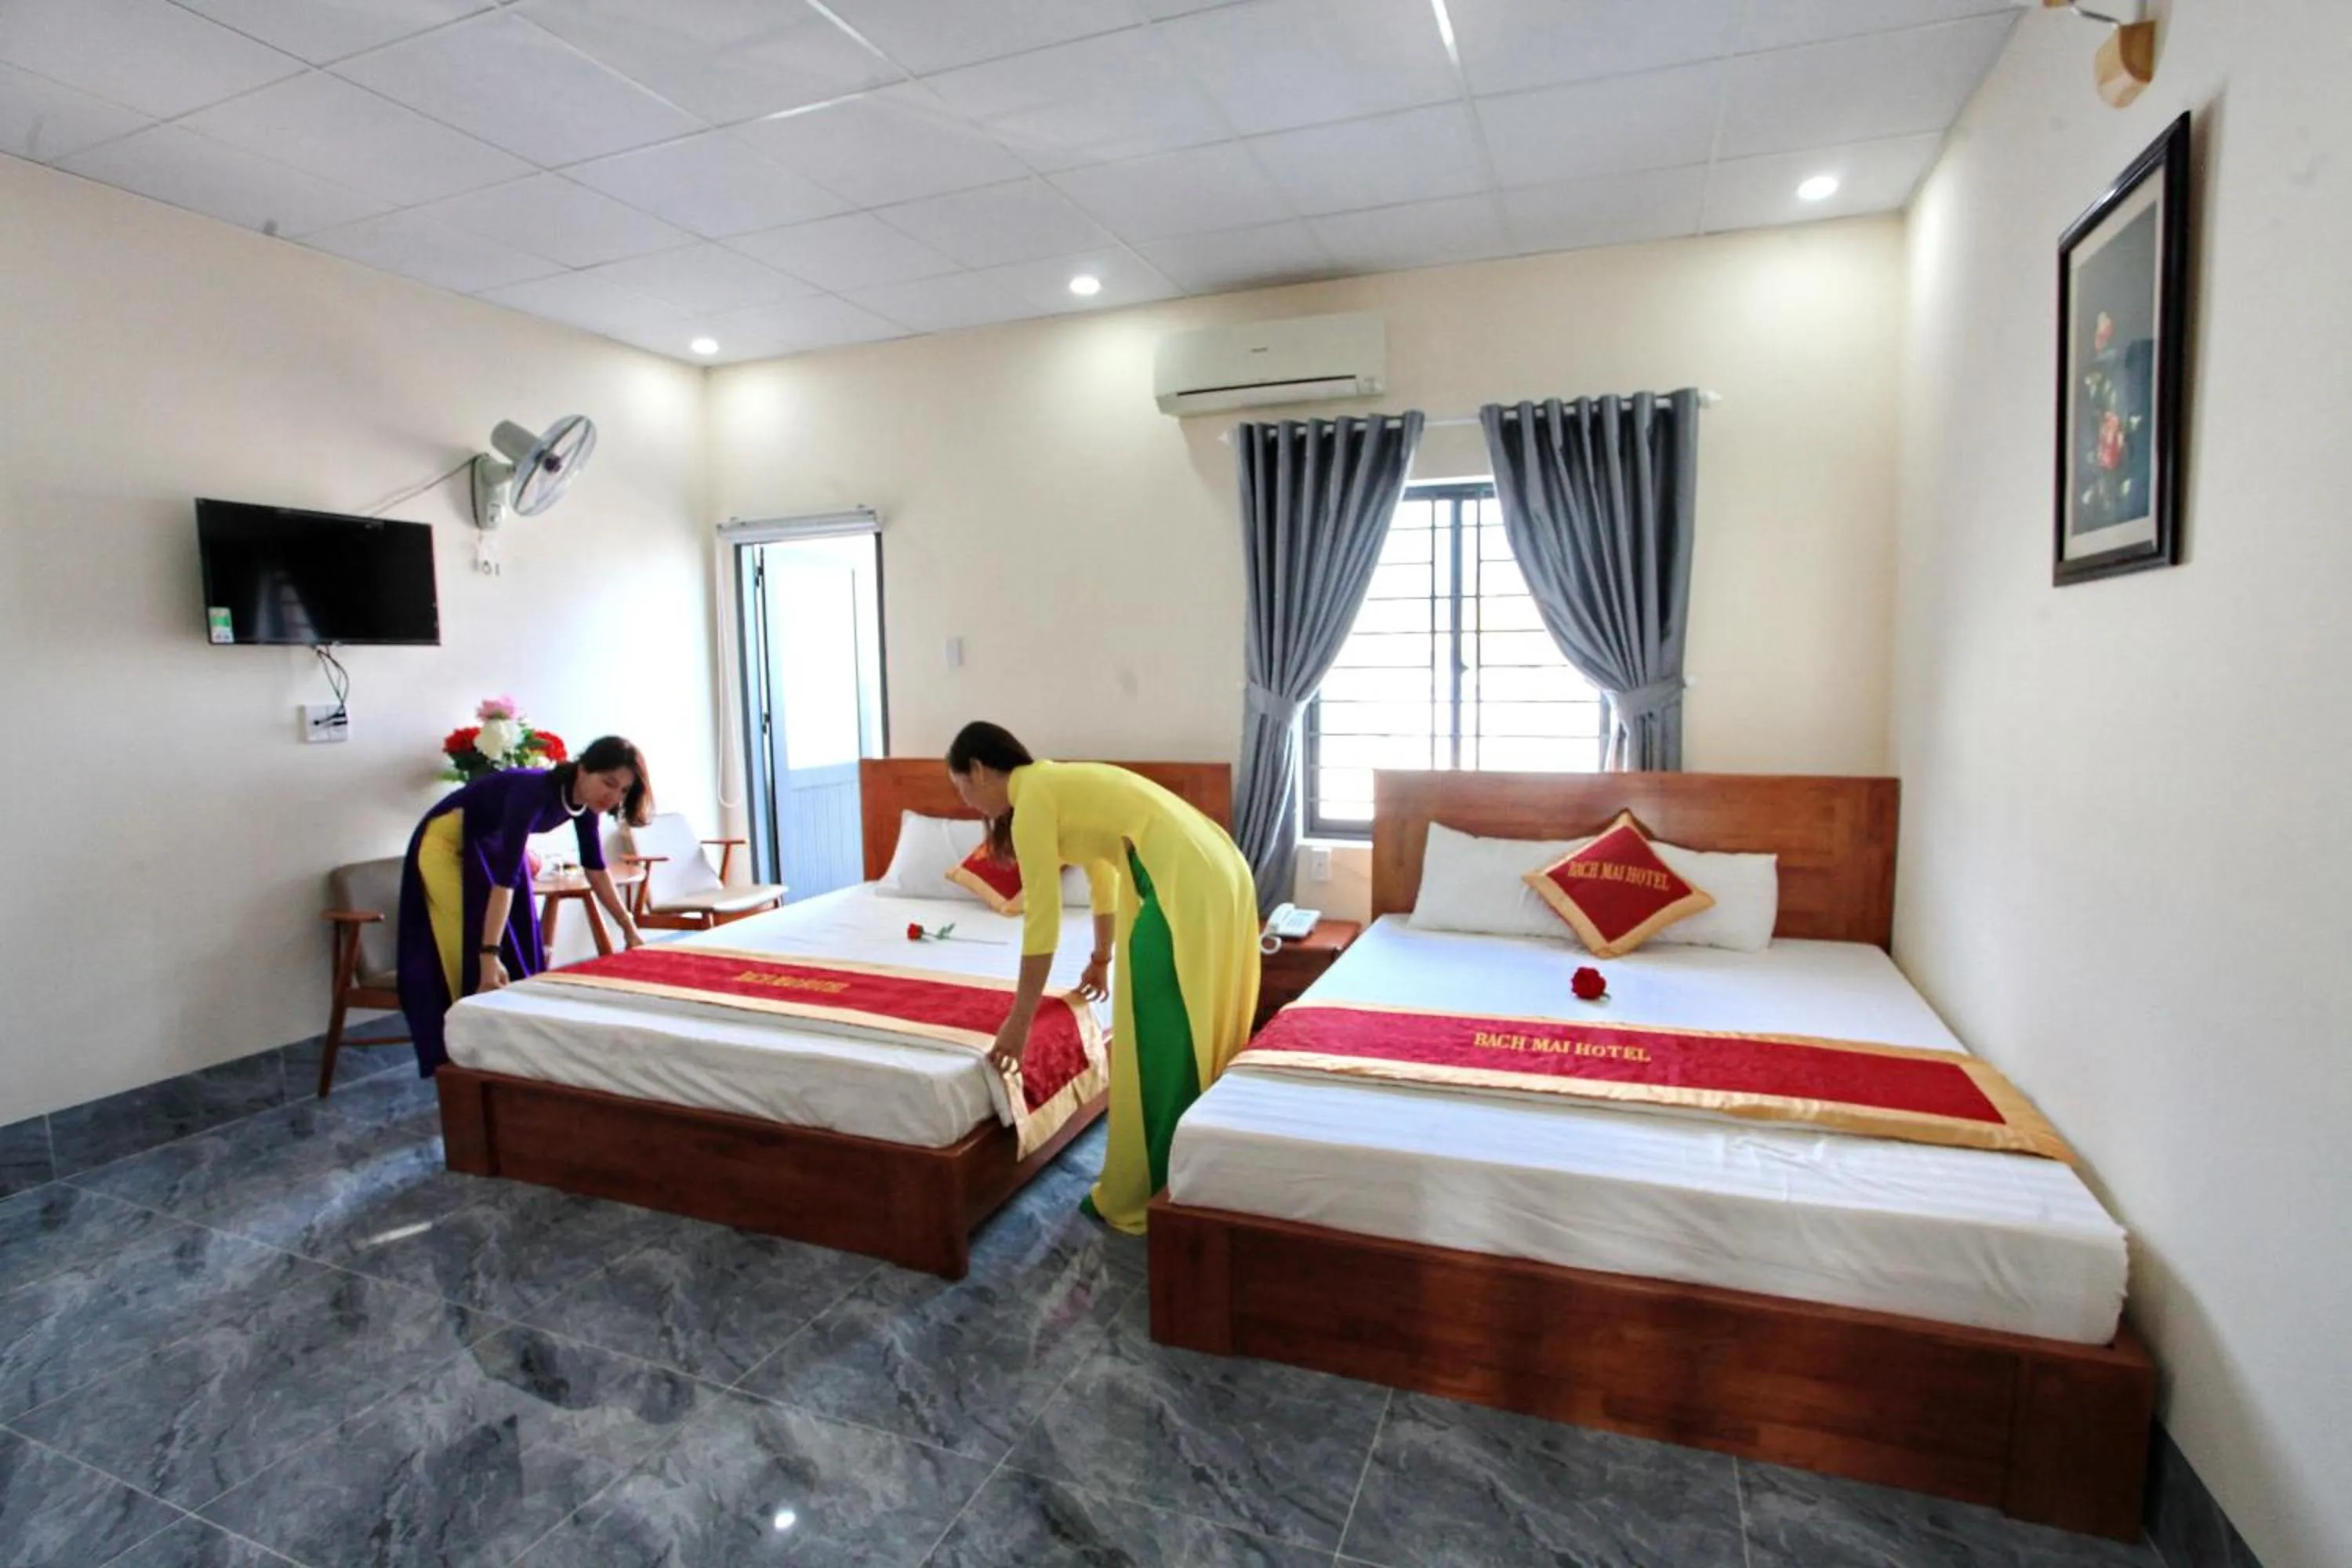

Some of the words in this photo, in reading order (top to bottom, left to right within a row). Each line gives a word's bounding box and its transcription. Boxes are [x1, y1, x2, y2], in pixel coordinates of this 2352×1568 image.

[1600, 862, 1624, 880] MAI
[1625, 866, 1669, 891] HOTEL
[1531, 1037, 1571, 1054] MAI
[1574, 1042, 1652, 1062] HOTEL
